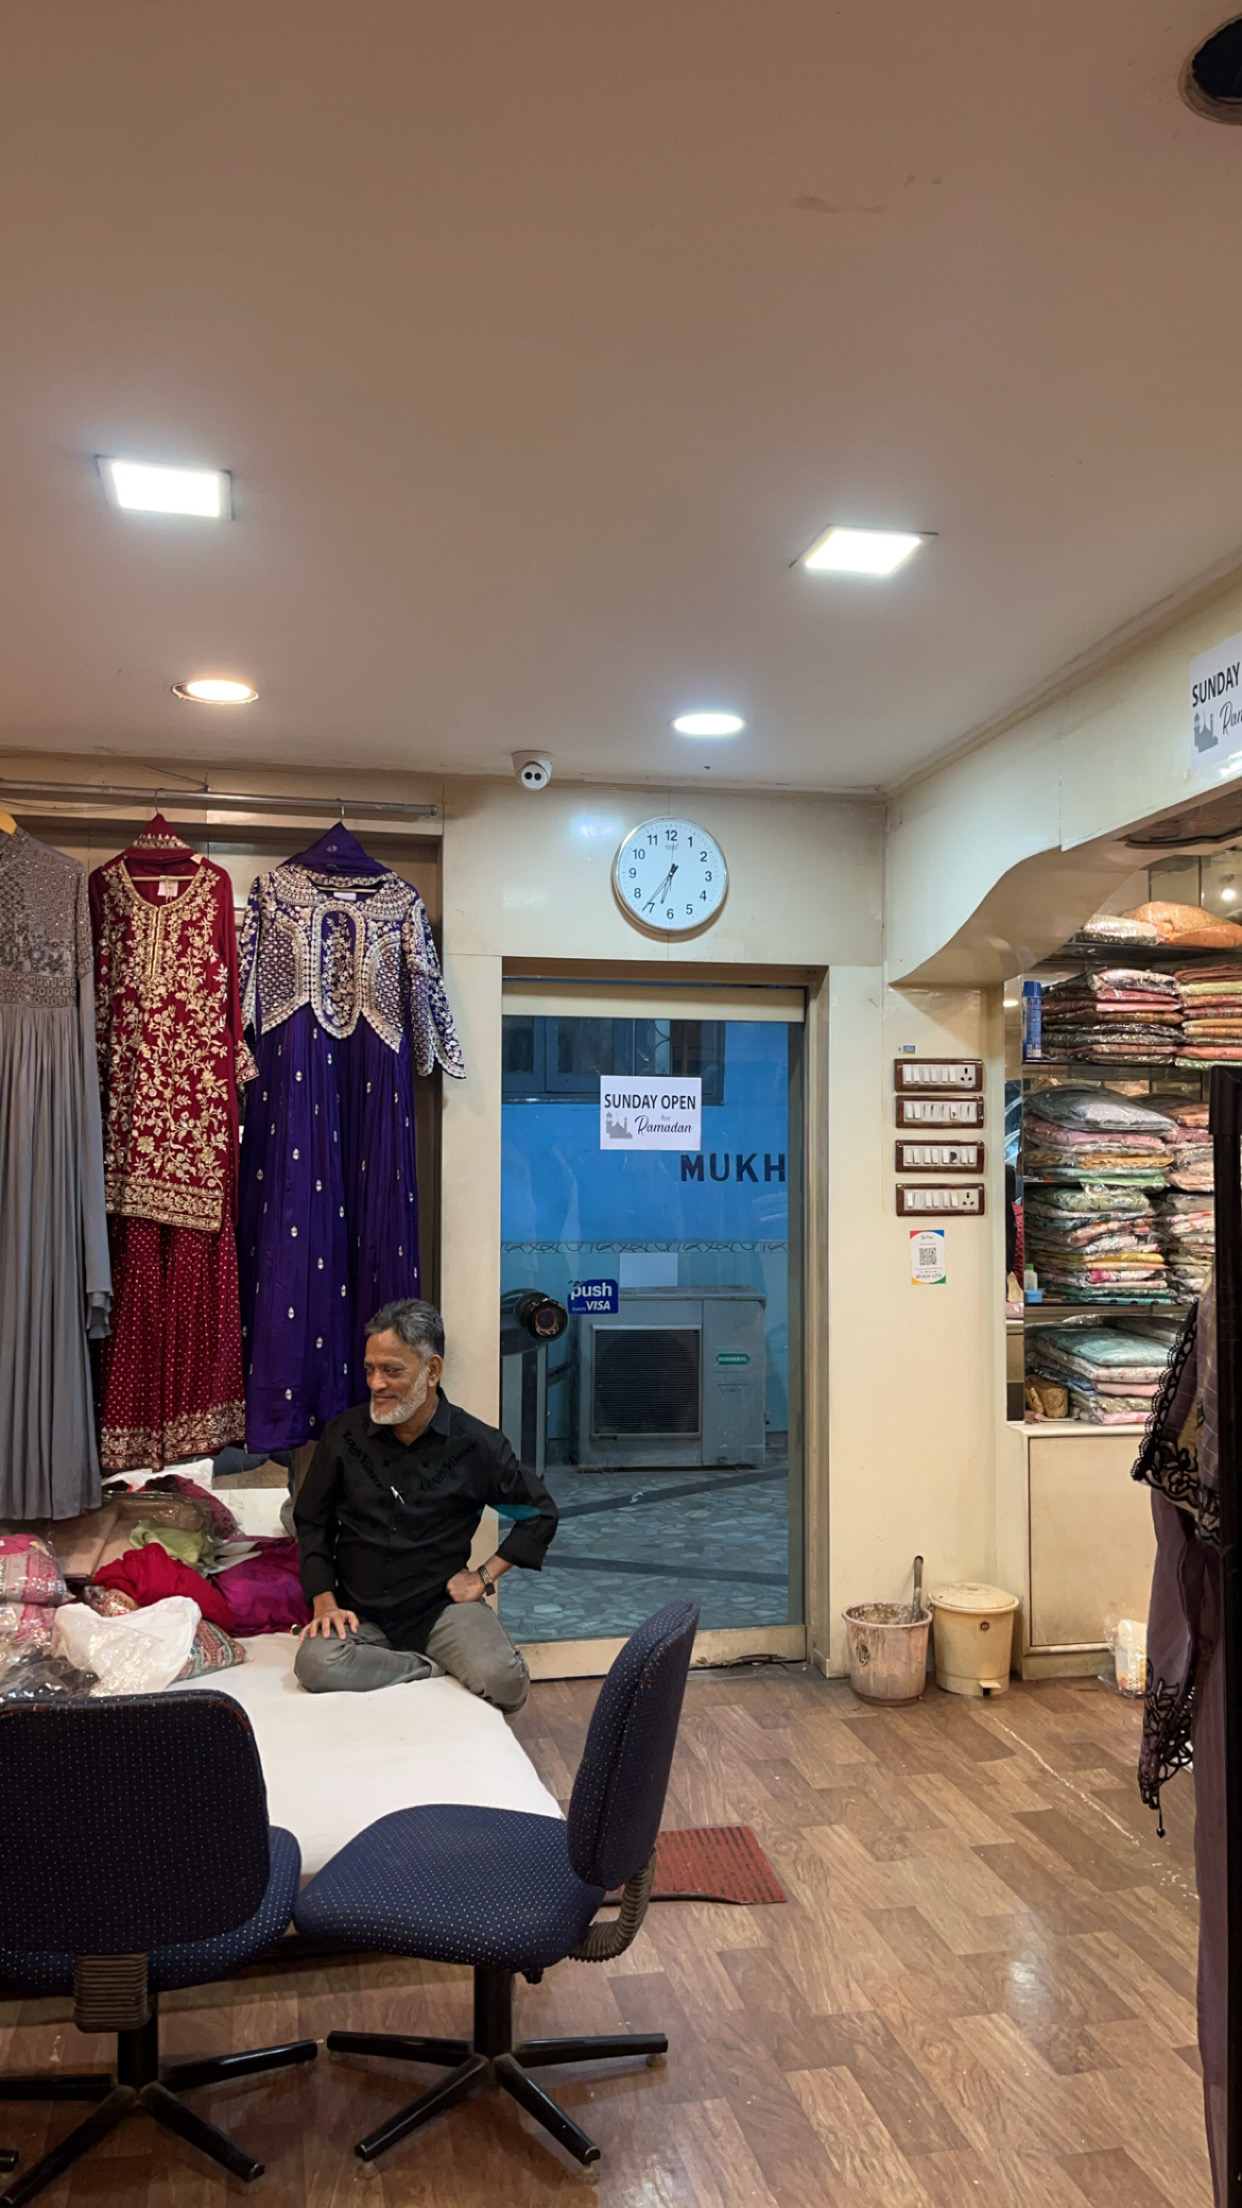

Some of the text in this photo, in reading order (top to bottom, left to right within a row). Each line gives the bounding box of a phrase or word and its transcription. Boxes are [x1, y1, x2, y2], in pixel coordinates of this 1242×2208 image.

[1192, 662, 1240, 708] SUNDAY
[647, 834, 658, 846] 11
[665, 830, 678, 841] 12
[632, 848, 646, 860] 10
[700, 851, 708, 862] 2
[628, 867, 637, 878] 9
[705, 871, 712, 882] 3
[634, 888, 641, 898] 8
[699, 890, 707, 901] 4
[647, 902, 656, 913] 7
[685, 904, 693, 915] 5
[666, 908, 674, 920] 6
[604, 1093, 696, 1110] SUNDAY OPEN
[634, 1114, 693, 1136] Ramadan
[681, 1153, 786, 1182] MUKH
[570, 1281, 613, 1301] push
[584, 1300, 611, 1311] VISA
